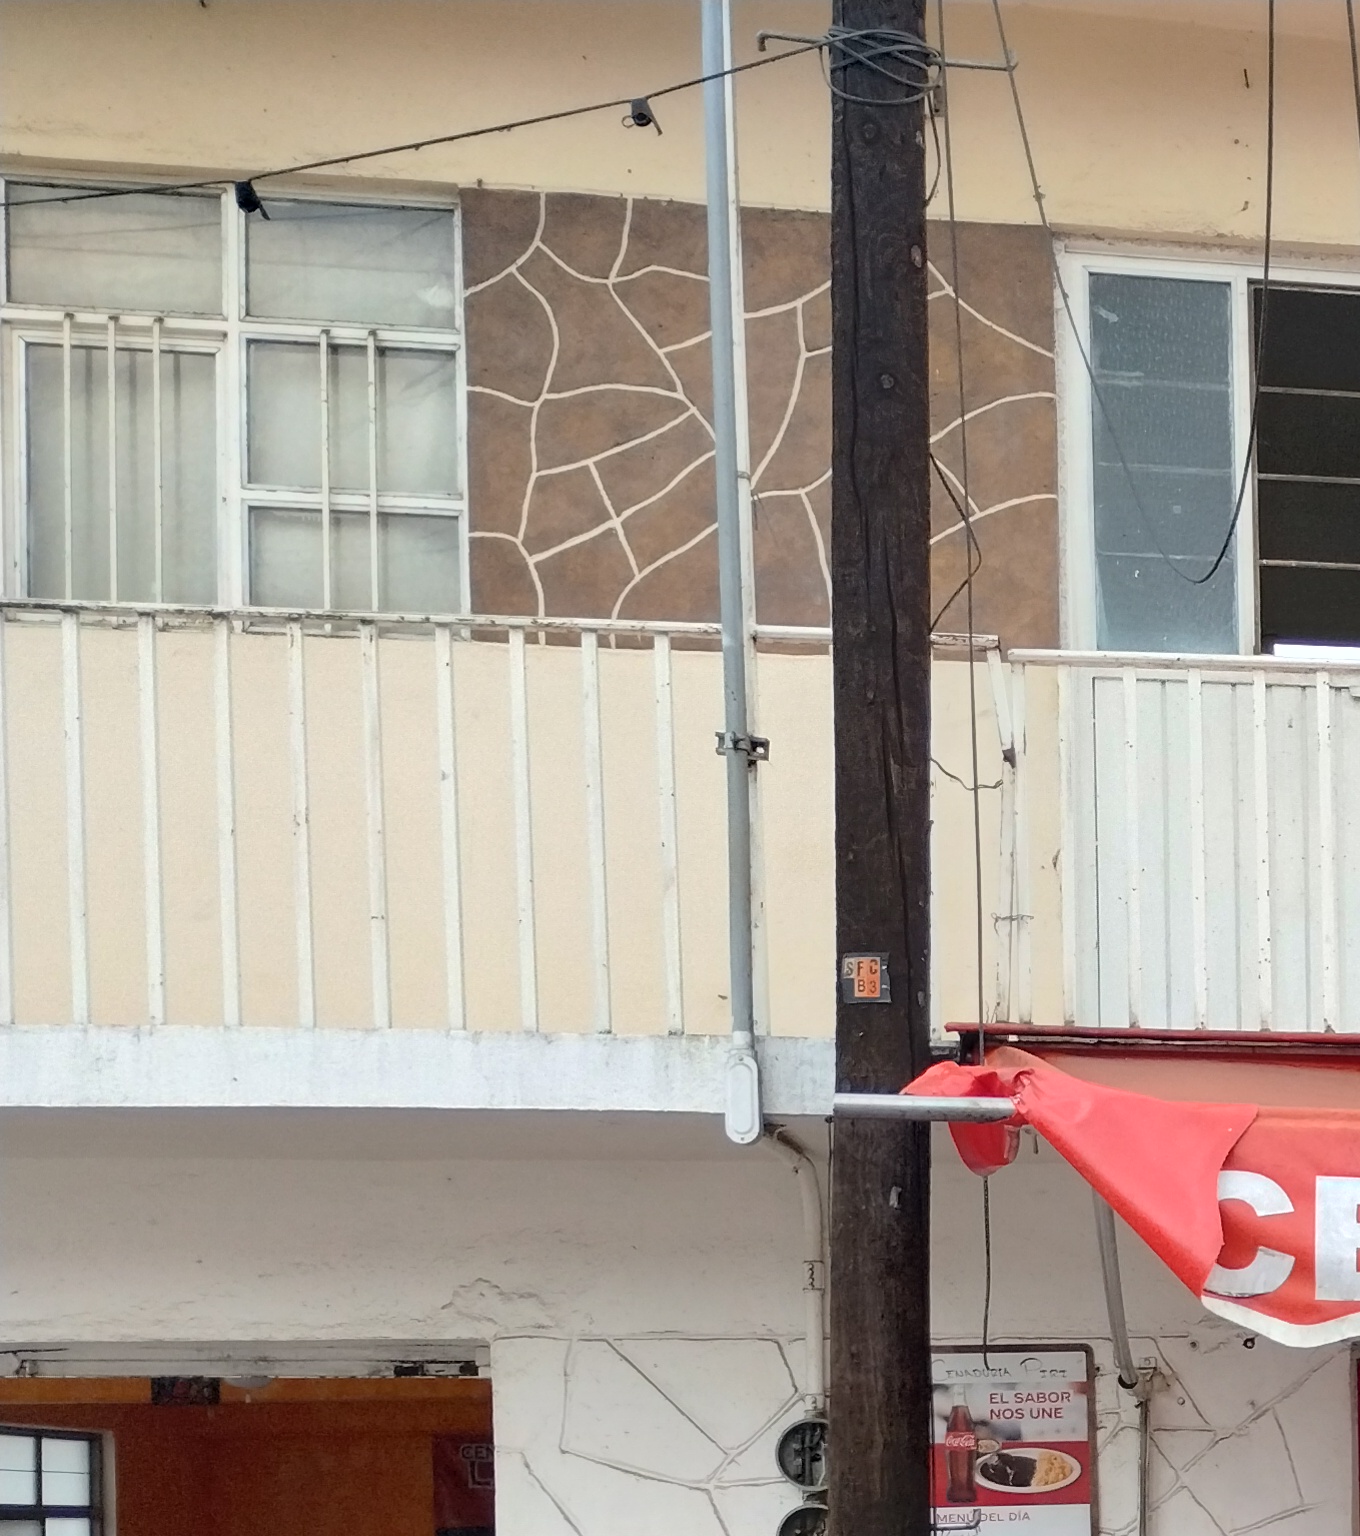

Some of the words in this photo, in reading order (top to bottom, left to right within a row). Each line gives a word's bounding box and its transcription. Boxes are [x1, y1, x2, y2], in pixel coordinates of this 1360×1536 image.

[857, 979, 877, 994] B3
[990, 1393, 1009, 1404] EL
[1014, 1391, 1071, 1403] SABOR
[990, 1408, 1024, 1420] NOS
[1030, 1407, 1063, 1419] UNE
